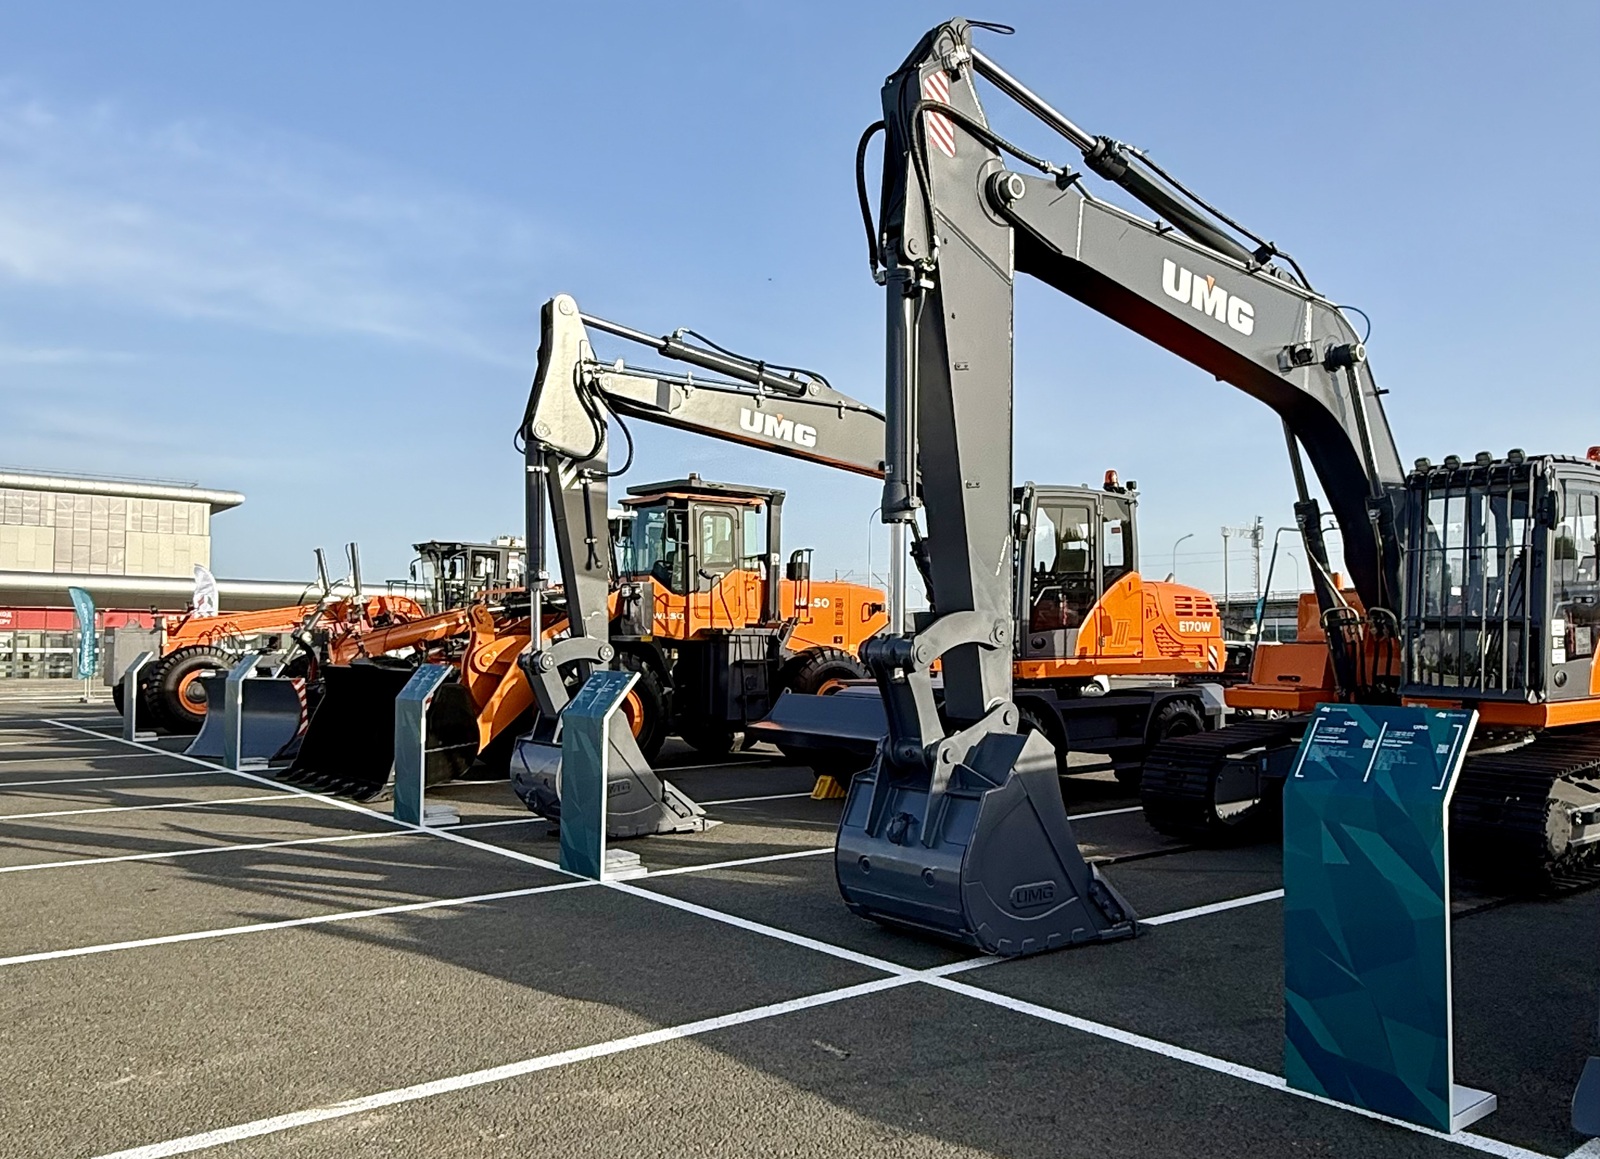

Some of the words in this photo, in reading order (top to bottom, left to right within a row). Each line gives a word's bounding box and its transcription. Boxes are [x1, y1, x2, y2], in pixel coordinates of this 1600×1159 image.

[1162, 258, 1255, 336] UMG
[740, 407, 817, 448] UMG
[1179, 621, 1211, 632] E170W
[1016, 886, 1054, 903] UMG
